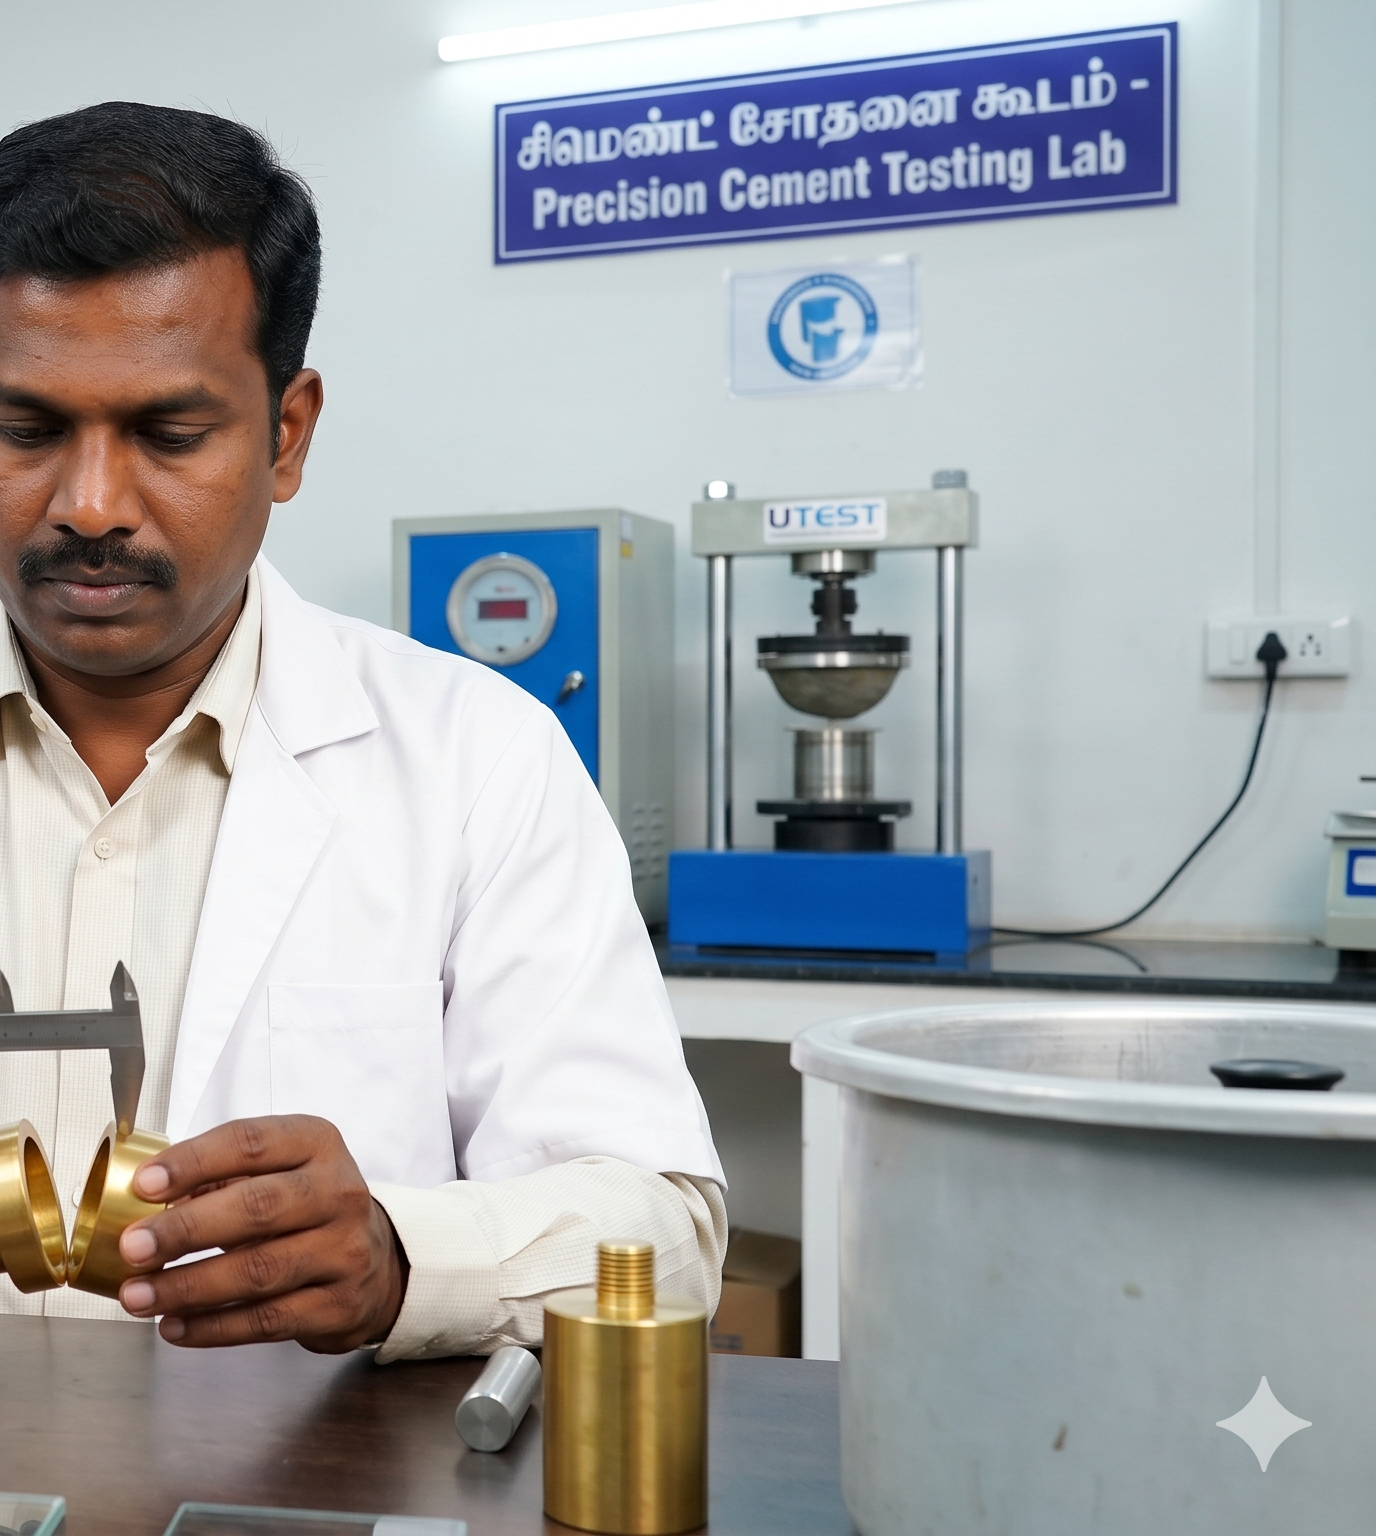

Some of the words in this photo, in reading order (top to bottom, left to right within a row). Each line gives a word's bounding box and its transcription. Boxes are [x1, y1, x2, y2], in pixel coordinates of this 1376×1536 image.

[517, 106, 718, 171] சிமெண்ட்
[729, 87, 961, 149] சோதனை
[972, 56, 1117, 121] கூடம்
[532, 175, 708, 231] Precision
[719, 156, 872, 213] Cement
[881, 142, 1034, 194] Testing
[1047, 129, 1127, 181] Lab
[769, 503, 880, 529] UTEST
